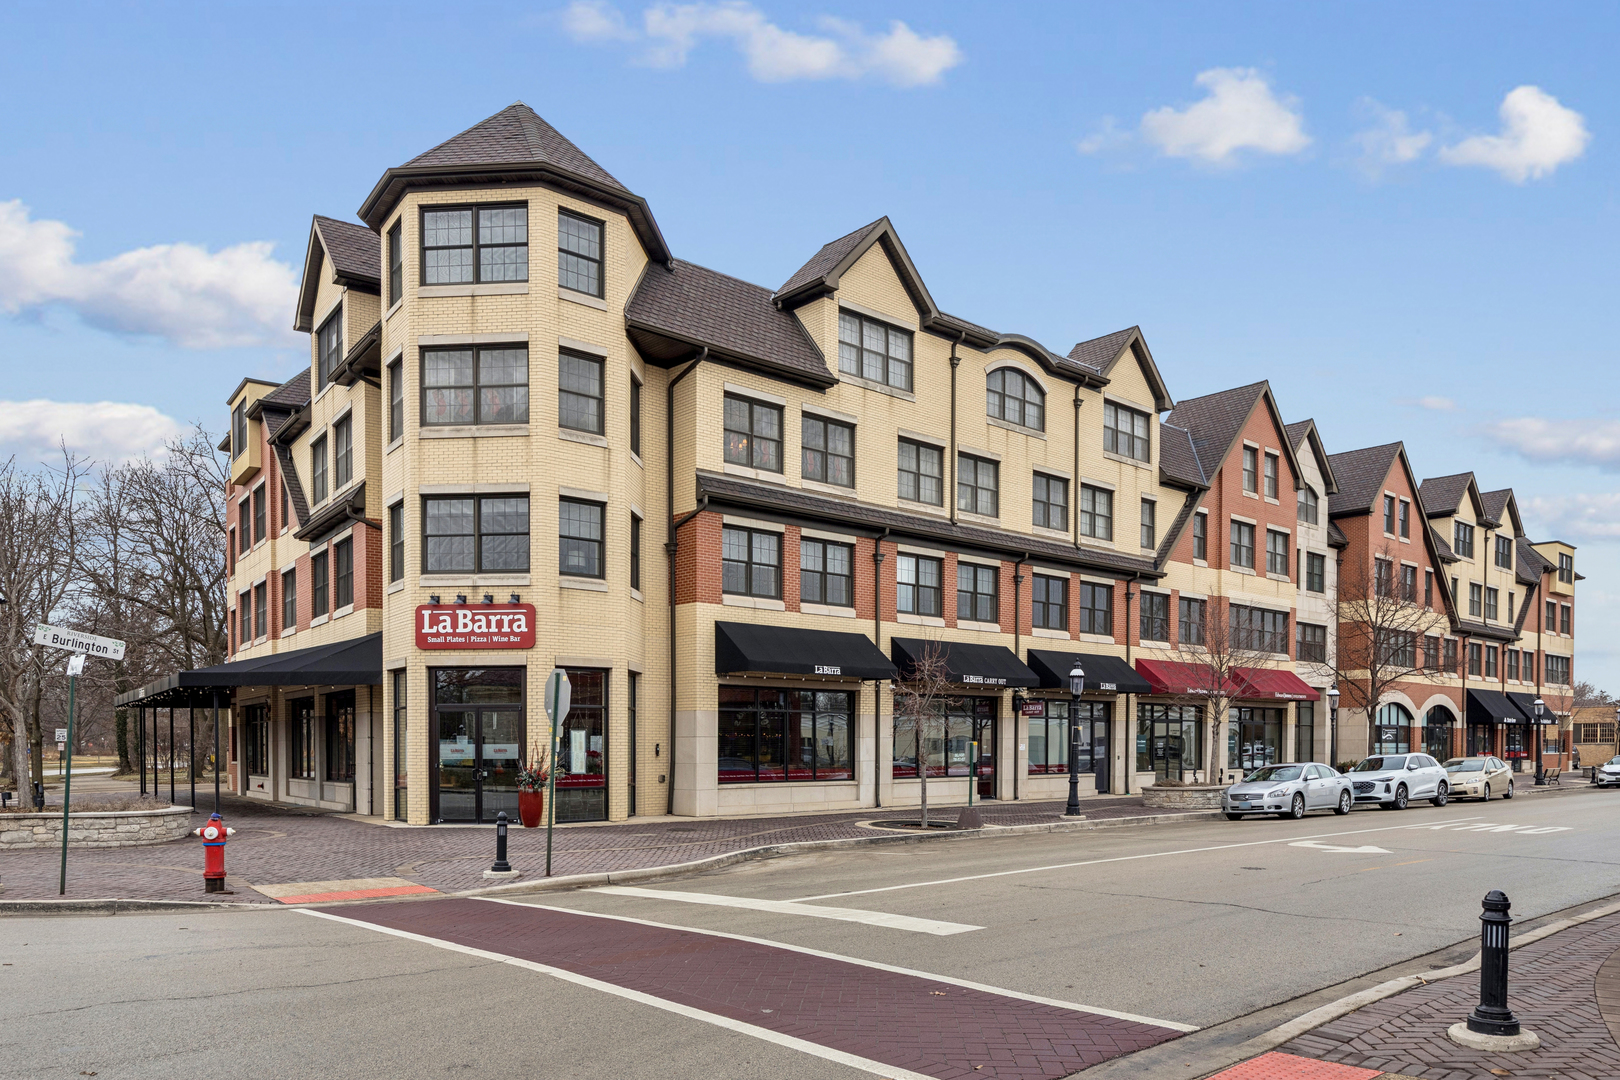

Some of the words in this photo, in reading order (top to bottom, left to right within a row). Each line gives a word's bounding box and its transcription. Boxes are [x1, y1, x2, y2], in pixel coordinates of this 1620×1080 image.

[66, 631, 97, 642] RIVERSIDE
[470, 635, 487, 643] Pizza
[51, 633, 108, 654] Burlington
